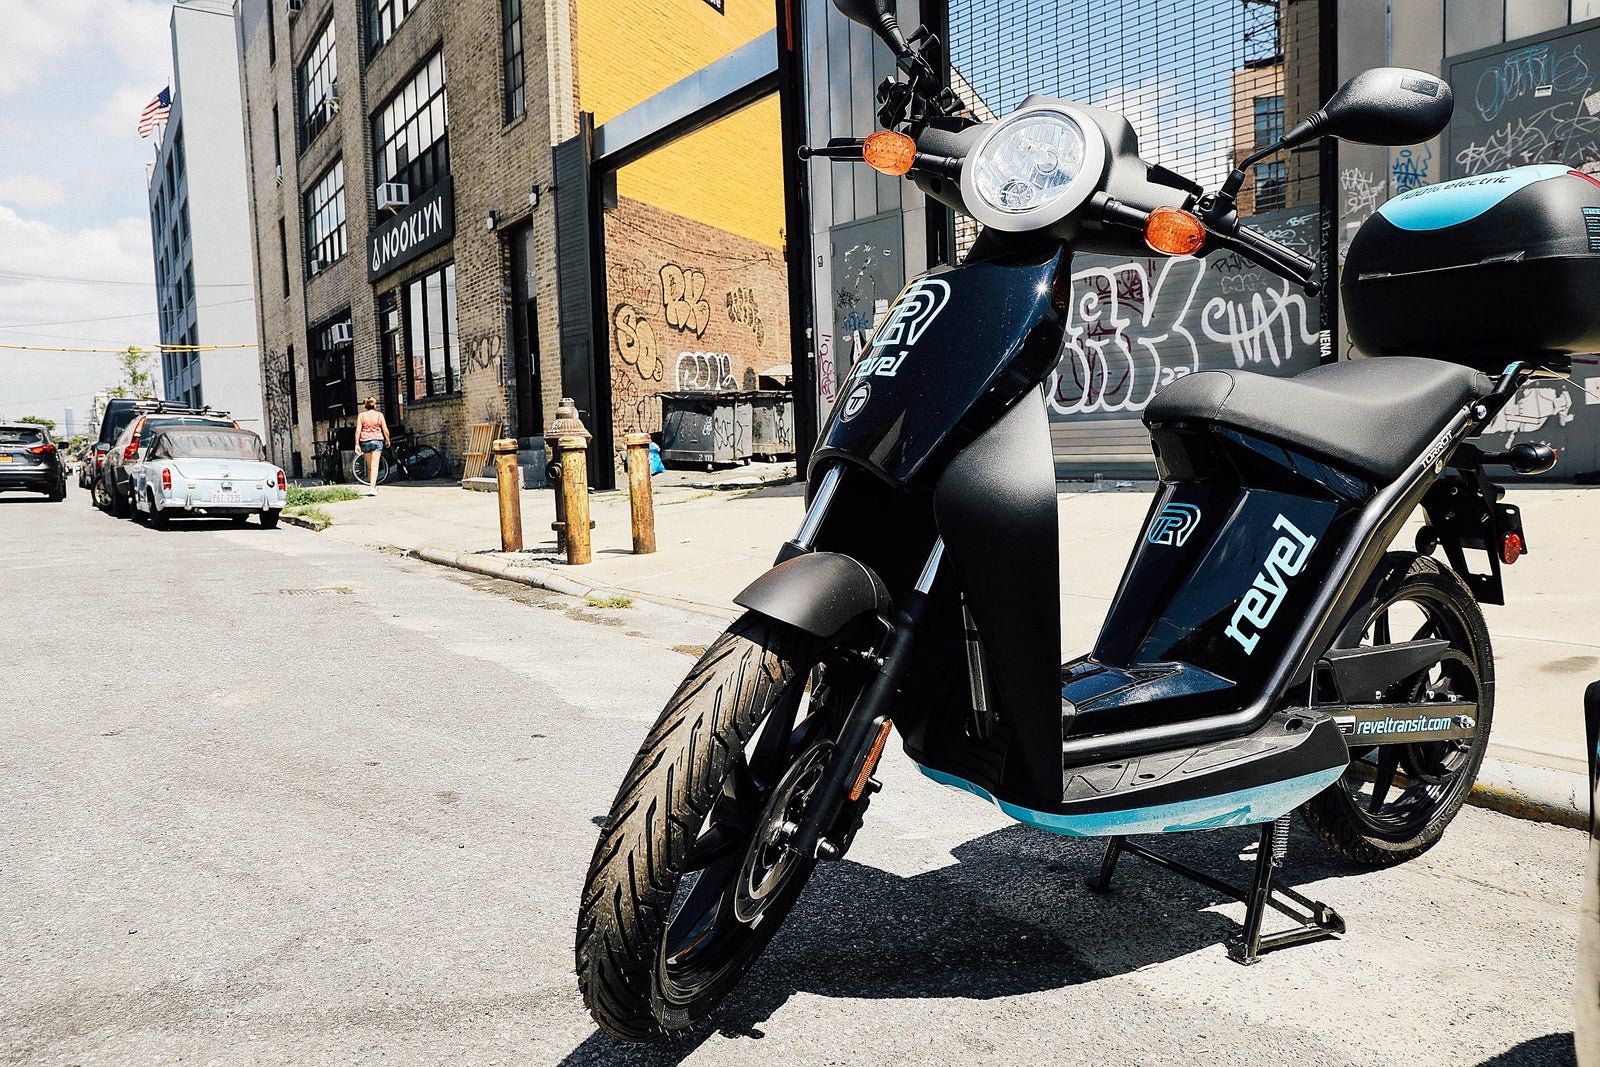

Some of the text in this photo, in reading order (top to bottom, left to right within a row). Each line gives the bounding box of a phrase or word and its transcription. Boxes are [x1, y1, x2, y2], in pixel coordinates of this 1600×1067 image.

[1443, 175, 1512, 190] electric
[382, 196, 443, 264] NOOKLYN
[1319, 329, 1332, 358] NENA
[849, 351, 909, 380] revel
[1419, 430, 1453, 469] TORROT
[1224, 513, 1317, 656] revel
[1356, 714, 1451, 735] reveltransit.com
